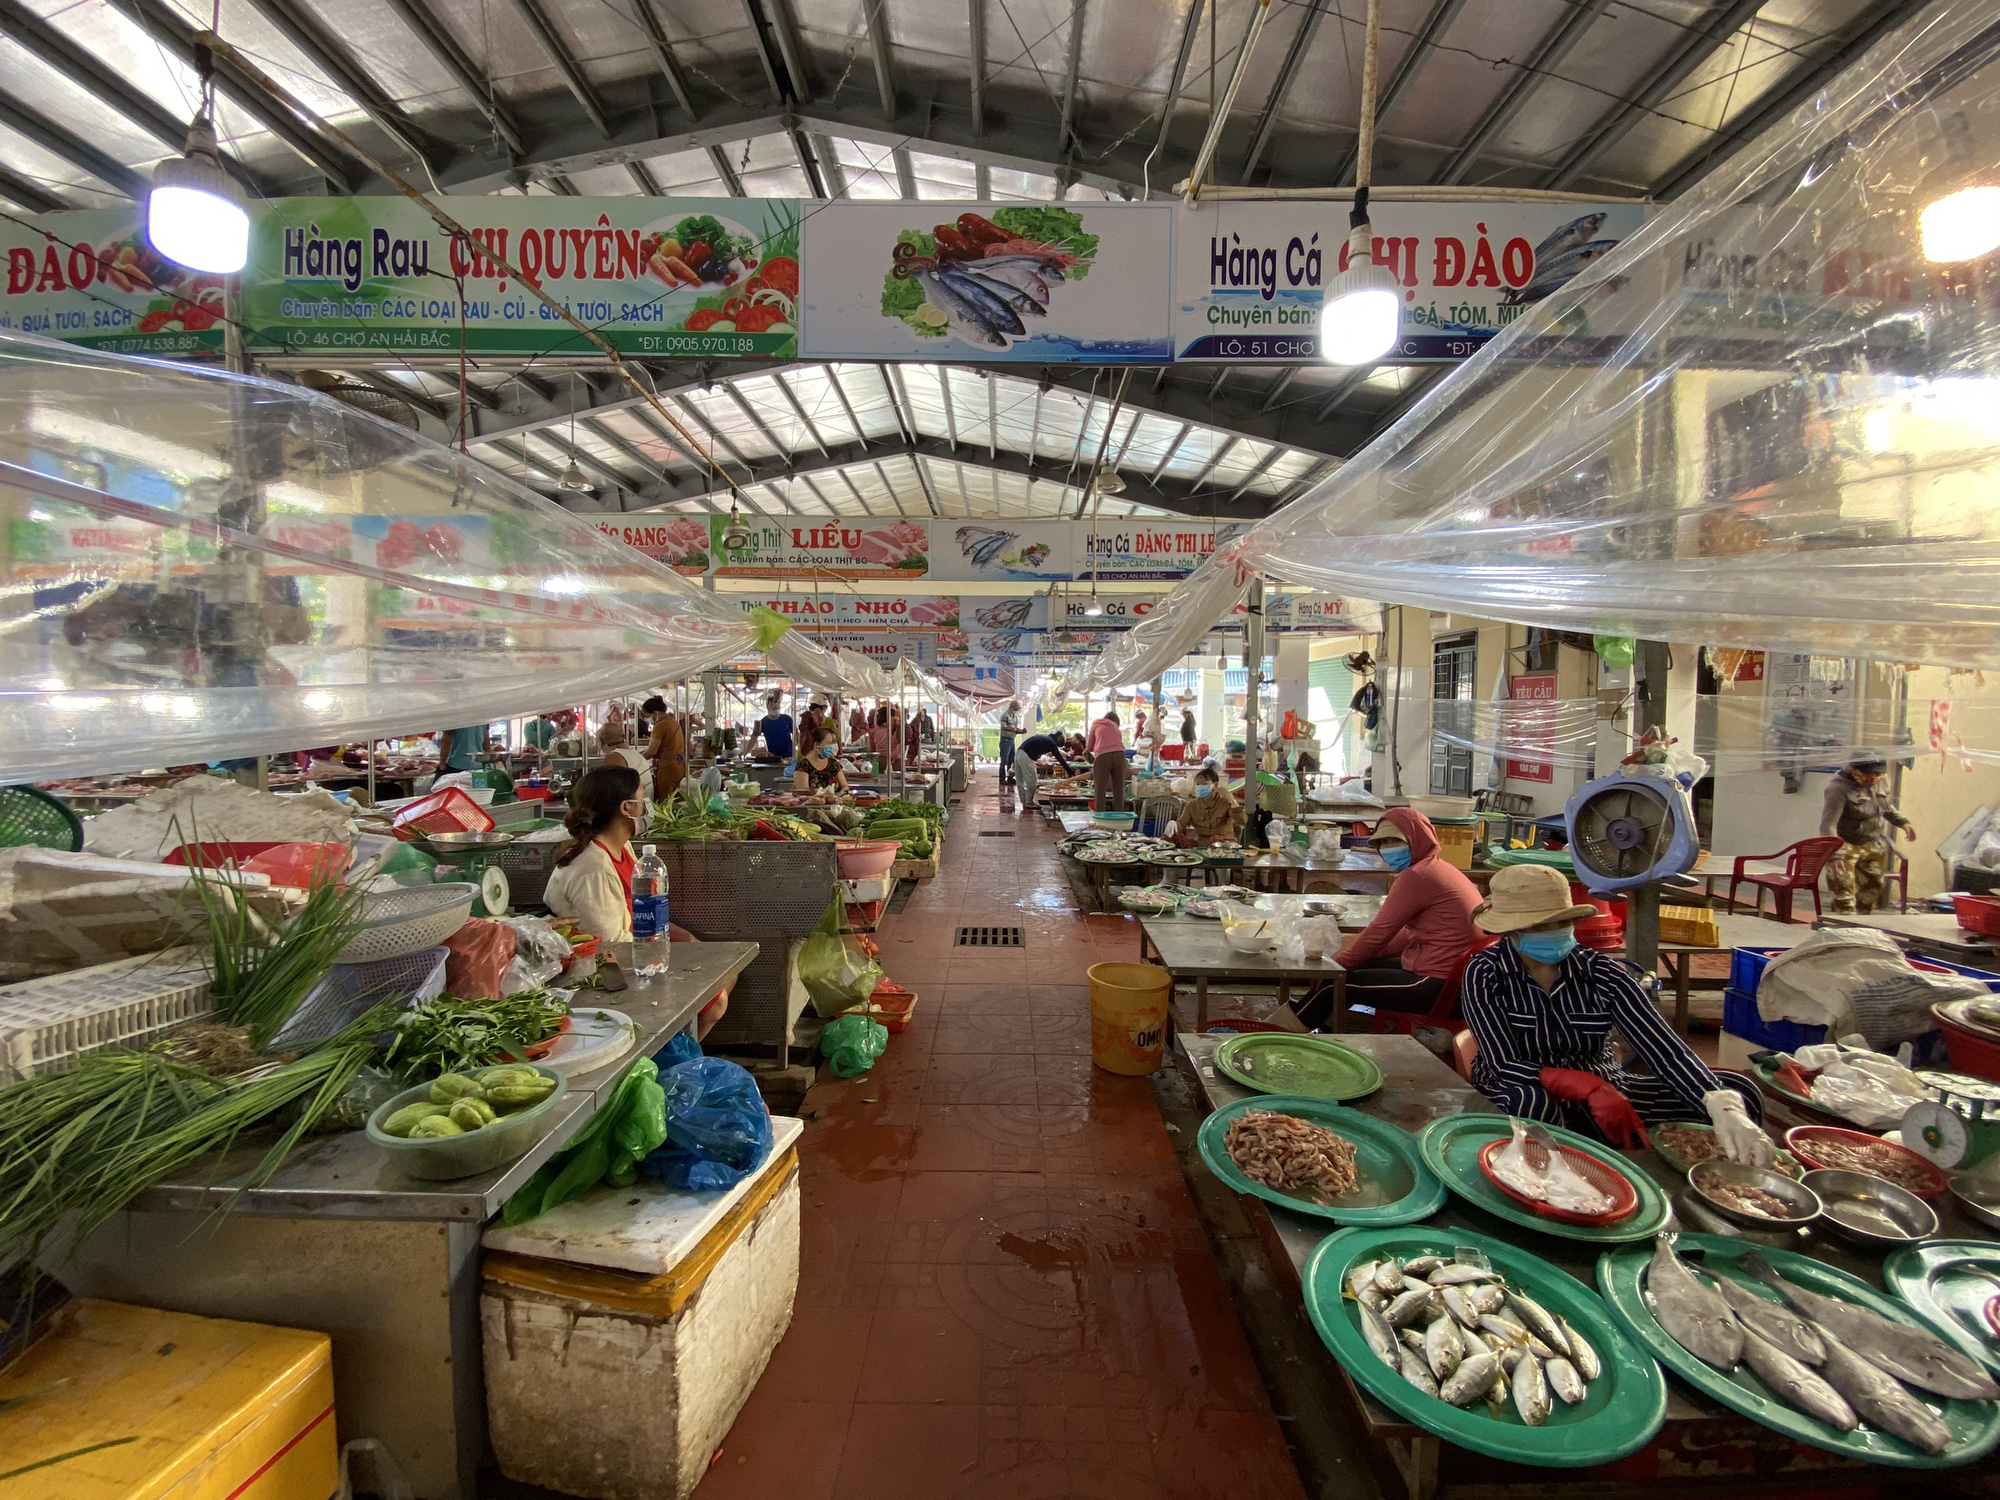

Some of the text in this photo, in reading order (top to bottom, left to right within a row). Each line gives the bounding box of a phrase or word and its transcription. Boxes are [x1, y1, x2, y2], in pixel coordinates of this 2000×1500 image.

[284, 213, 641, 293] Hàng Rau CHỊ QUYÊN
[1210, 231, 1277, 300] Hàng
[1286, 231, 1322, 286] Cá
[1432, 222, 1534, 288] ĐÀO
[281, 298, 338, 322] Chuyên
[343, 298, 376, 318] bán:
[381, 296, 416, 319] CÁC
[422, 301, 456, 324] LOẠI
[462, 301, 490, 319] RAU
[503, 295, 525, 320] CỦ
[621, 303, 663, 326] SẠCH
[1207, 304, 1272, 328] Chuyên
[1278, 304, 1316, 324] bán:
[287, 330, 309, 345] LÔ:
[313, 333, 329, 345] 46
[333, 331, 366, 347] CHỢ
[394, 330, 417, 346] HẢI
[421, 329, 450, 347] BẮC
[666, 337, 754, 352] 0905.970.188
[1219, 339, 1246, 355] LÔ:
[1251, 341, 1268, 355] 51
[1274, 340, 1314, 357] CHỢ
[623, 526, 668, 548] SANG
[762, 528, 782, 554] Thịt
[791, 518, 863, 549] LIỂU
[1115, 532, 1130, 553] Cá
[1136, 528, 1172, 558] ĐẶNG
[1176, 533, 1197, 558] THỊ
[729, 554, 763, 565] Chuyên
[789, 554, 810, 564] CÁC
[813, 556, 833, 566] LOẠI
[766, 596, 835, 614] THẢO
[855, 599, 907, 615] NHỚ
[1106, 602, 1126, 615] Cá
[1515, 685, 1532, 699] YÊU
[1137, 1030, 1162, 1048] OMO
